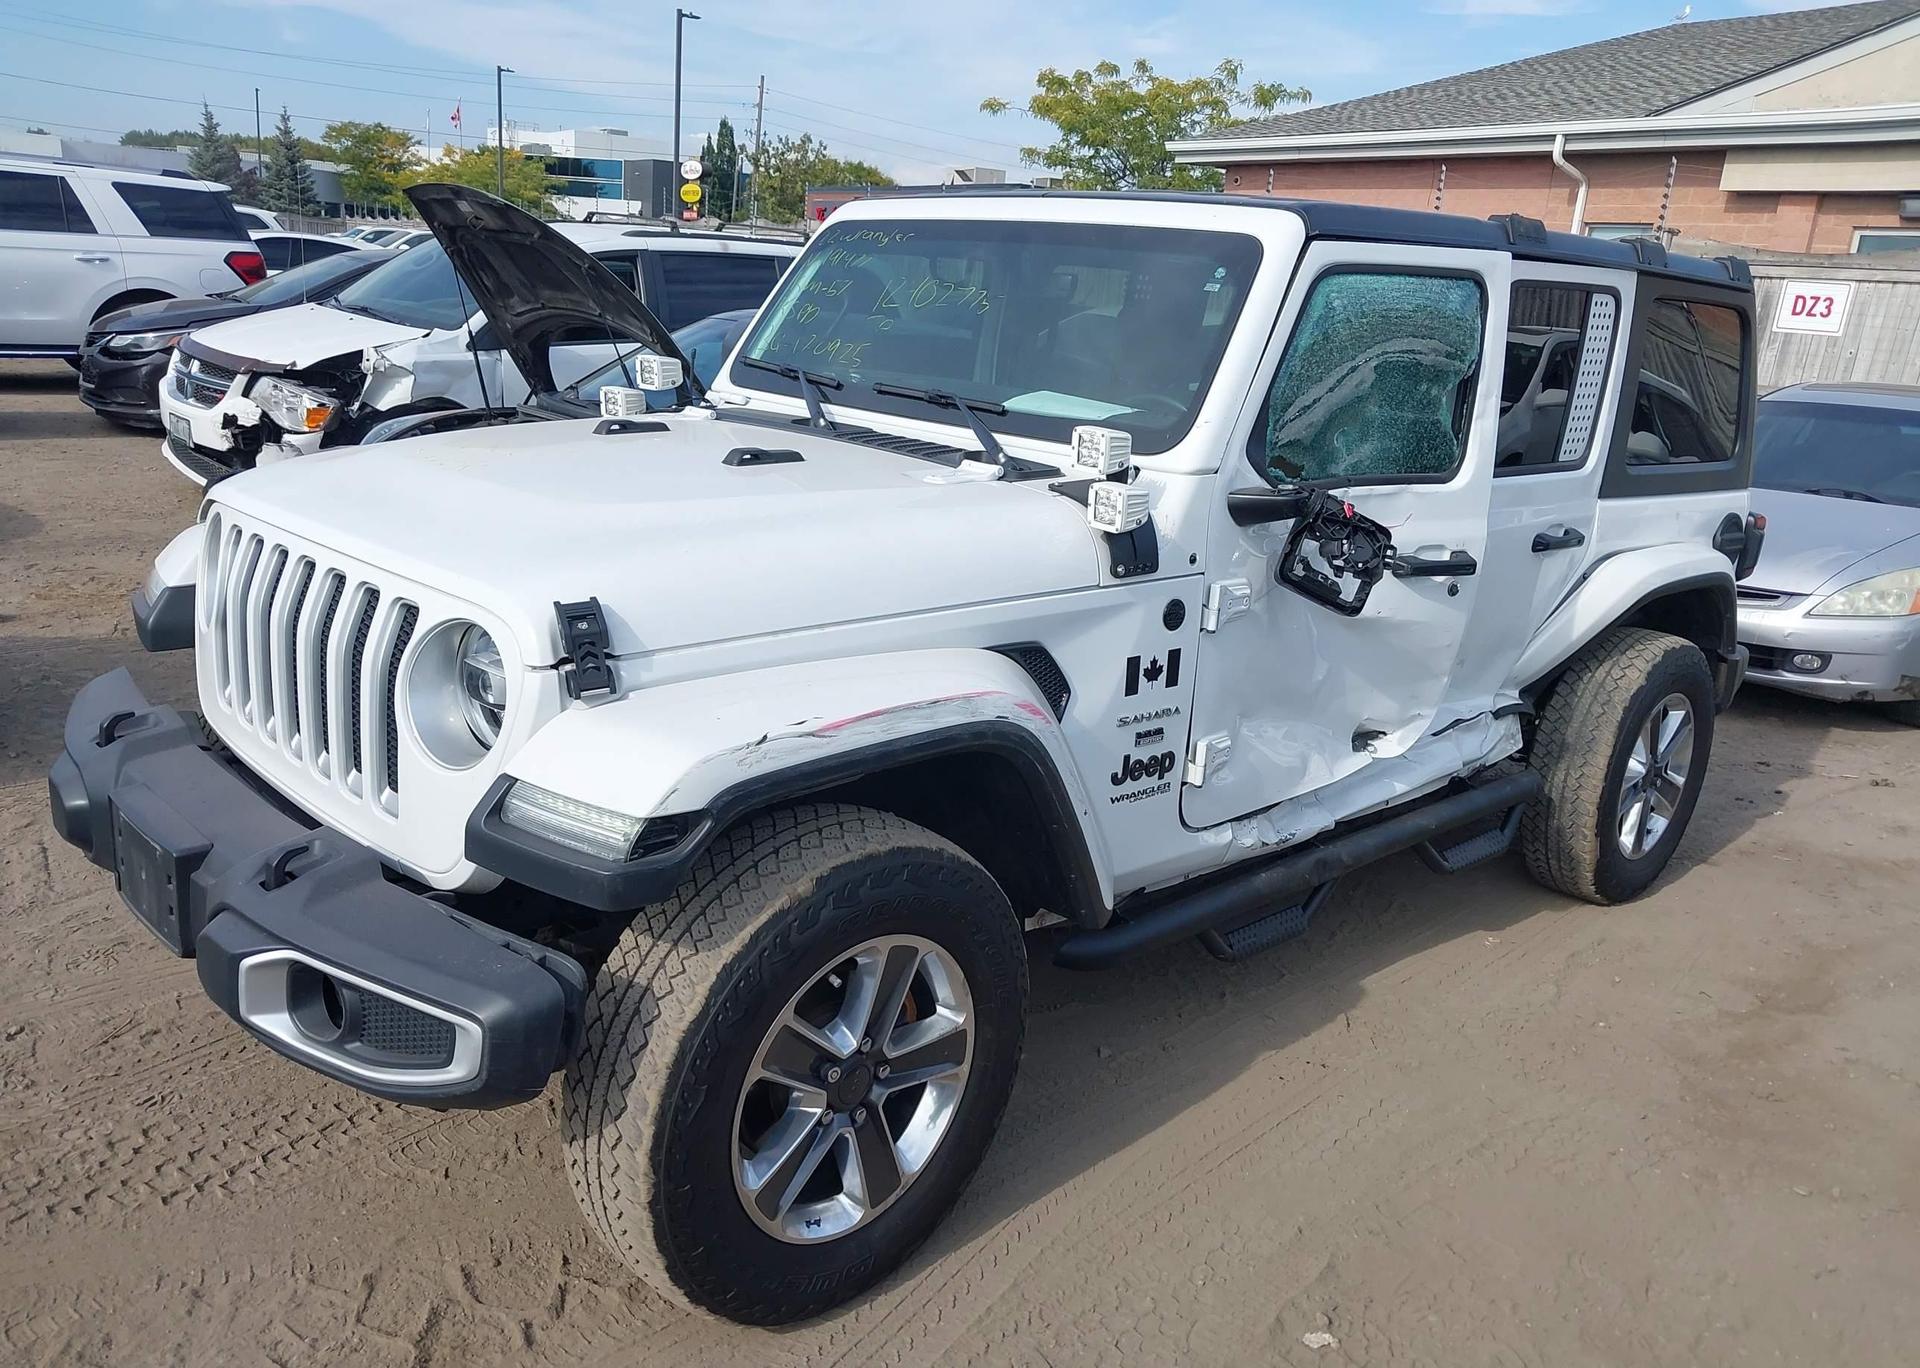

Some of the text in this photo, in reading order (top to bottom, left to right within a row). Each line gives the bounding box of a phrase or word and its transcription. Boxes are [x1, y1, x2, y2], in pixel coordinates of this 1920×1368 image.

[1791, 294, 1834, 318] DZ3
[1116, 706, 1181, 728] SAHARA
[1111, 750, 1175, 786] Jeep
[1110, 782, 1171, 805] WRANGLER
